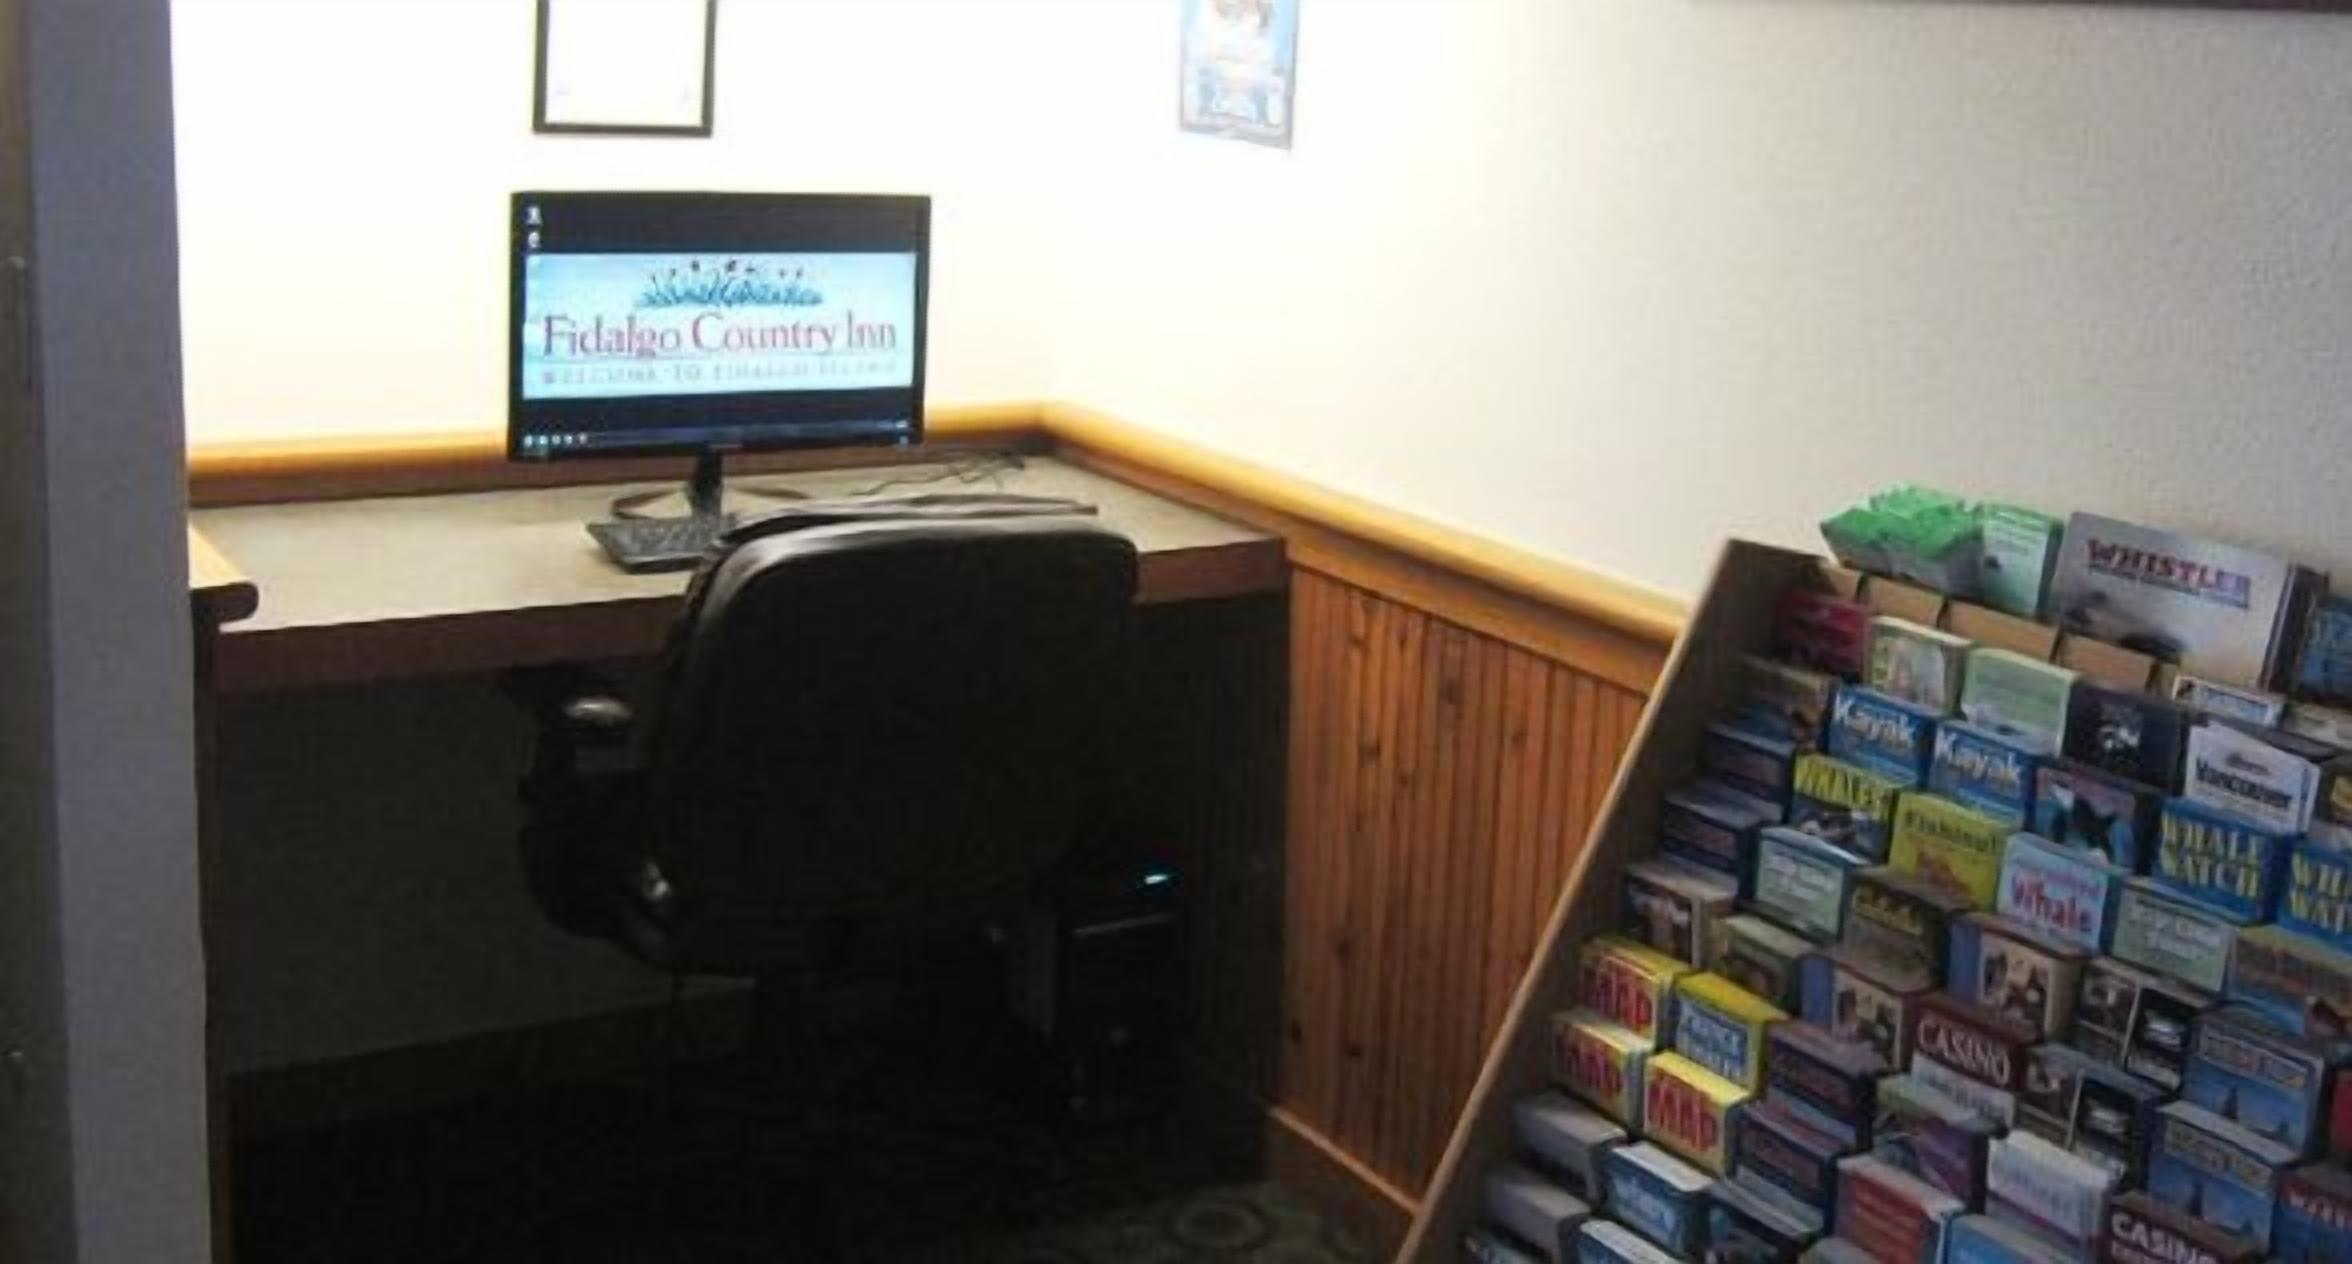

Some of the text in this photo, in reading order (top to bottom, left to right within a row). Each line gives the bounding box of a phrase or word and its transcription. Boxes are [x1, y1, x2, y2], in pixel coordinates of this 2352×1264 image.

[543, 309, 897, 357] Fidalgo Country Inn
[1834, 692, 1915, 750] Kayak
[1934, 727, 2022, 790] Kayak
[2196, 757, 2294, 808] Vancouver
[2161, 811, 2259, 864] WHALE
[2160, 842, 2258, 897] WATCH
[2012, 873, 2093, 933] Whale
[1918, 1017, 2012, 1087] CASINO
